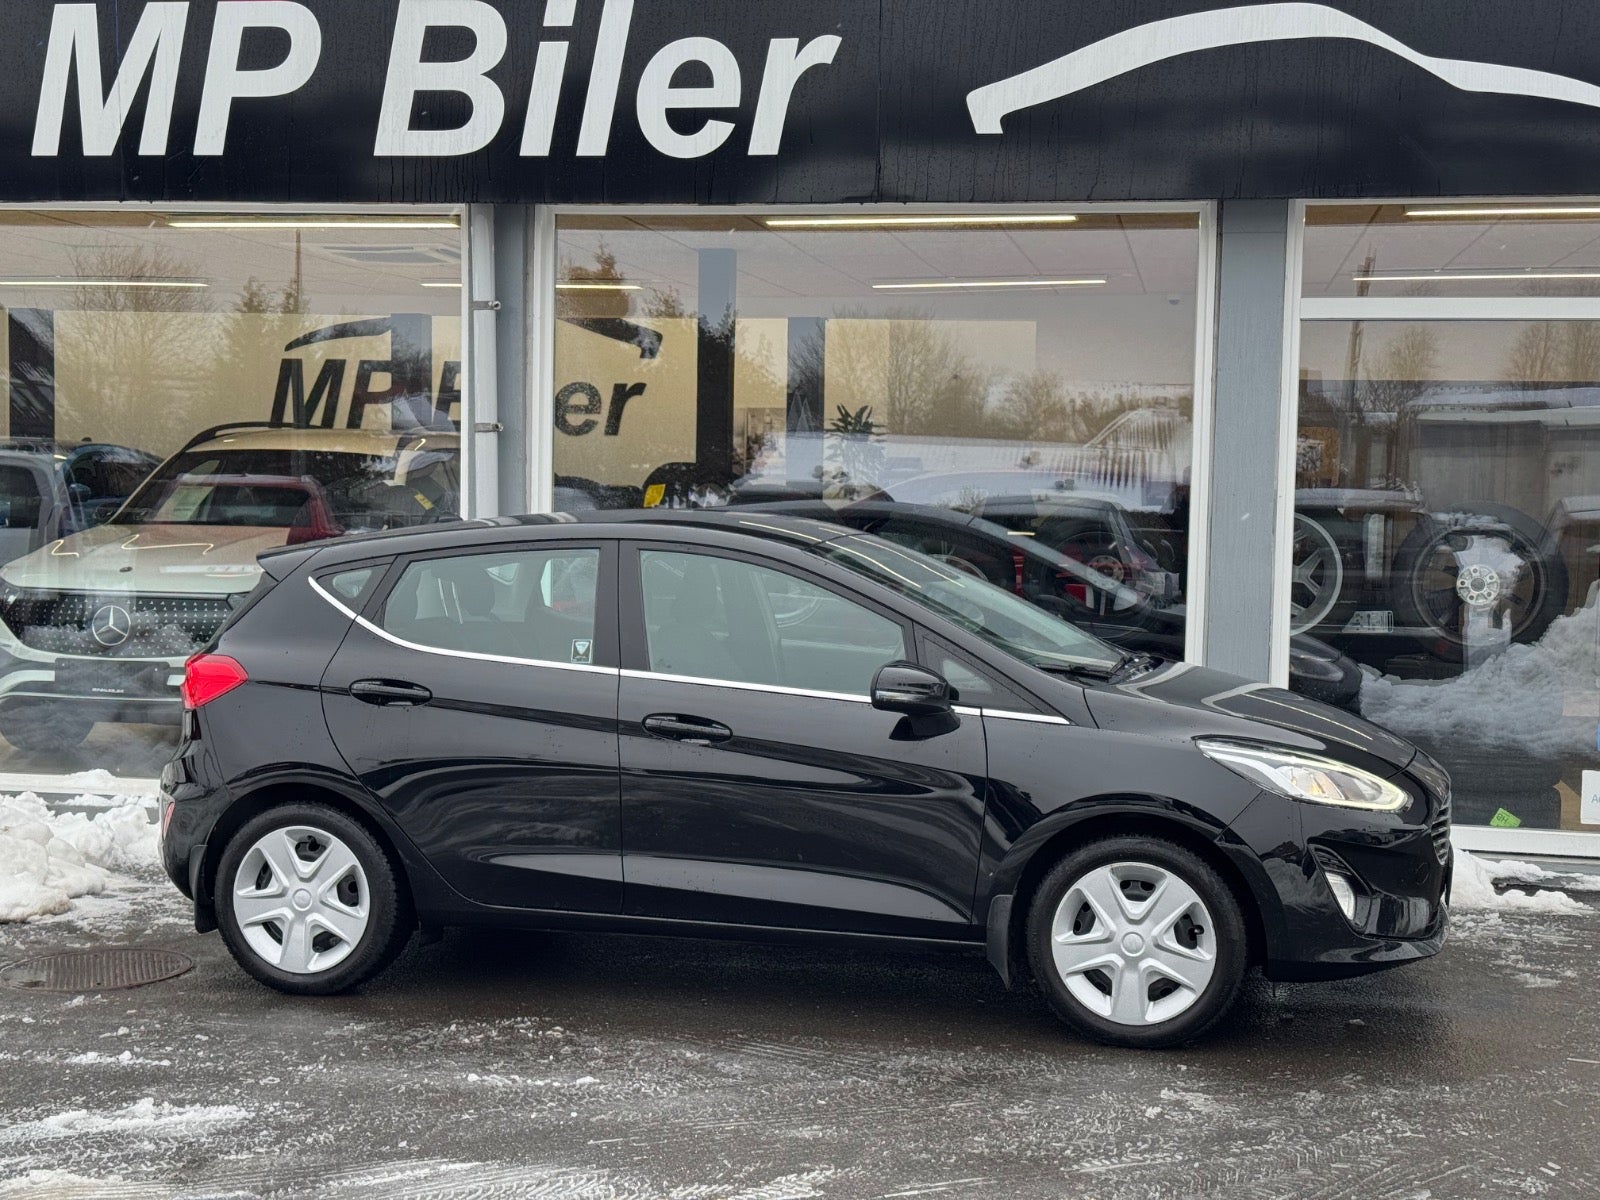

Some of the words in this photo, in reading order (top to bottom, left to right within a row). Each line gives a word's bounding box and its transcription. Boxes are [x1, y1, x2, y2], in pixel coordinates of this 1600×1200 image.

[31, 0, 322, 157] MP
[373, 0, 843, 158] Biler
[270, 358, 405, 430] MP
